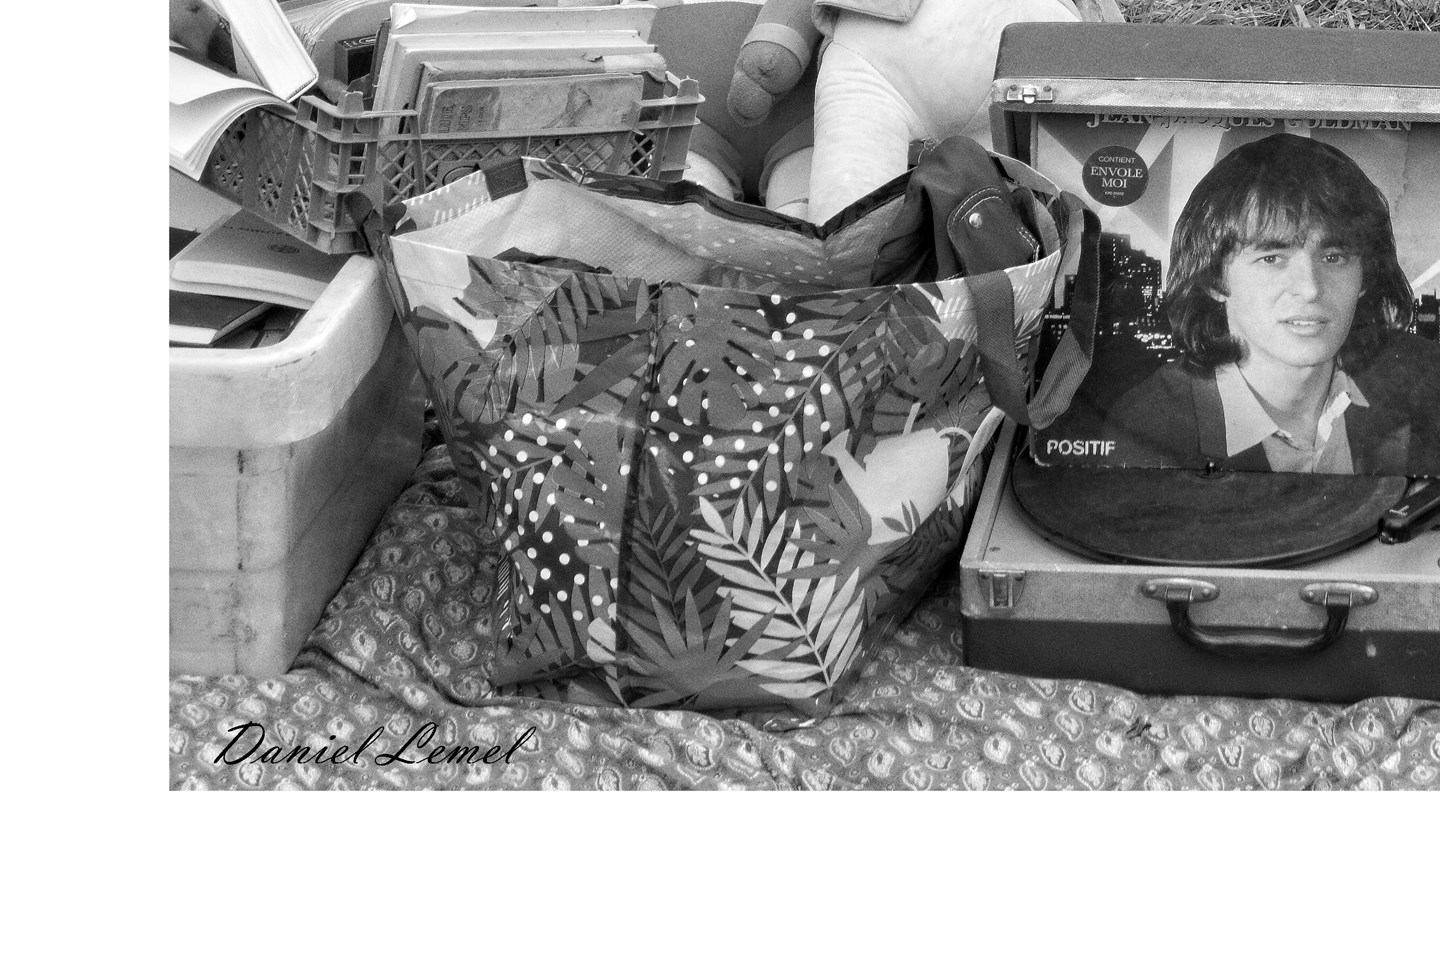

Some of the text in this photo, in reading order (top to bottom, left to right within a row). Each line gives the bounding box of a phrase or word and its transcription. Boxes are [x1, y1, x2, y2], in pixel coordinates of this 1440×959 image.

[1098, 155, 1136, 164] CONTIENT
[1090, 166, 1144, 178] ENVOLE
[1101, 177, 1127, 188] MOI
[1046, 439, 1116, 456] POSITIF
